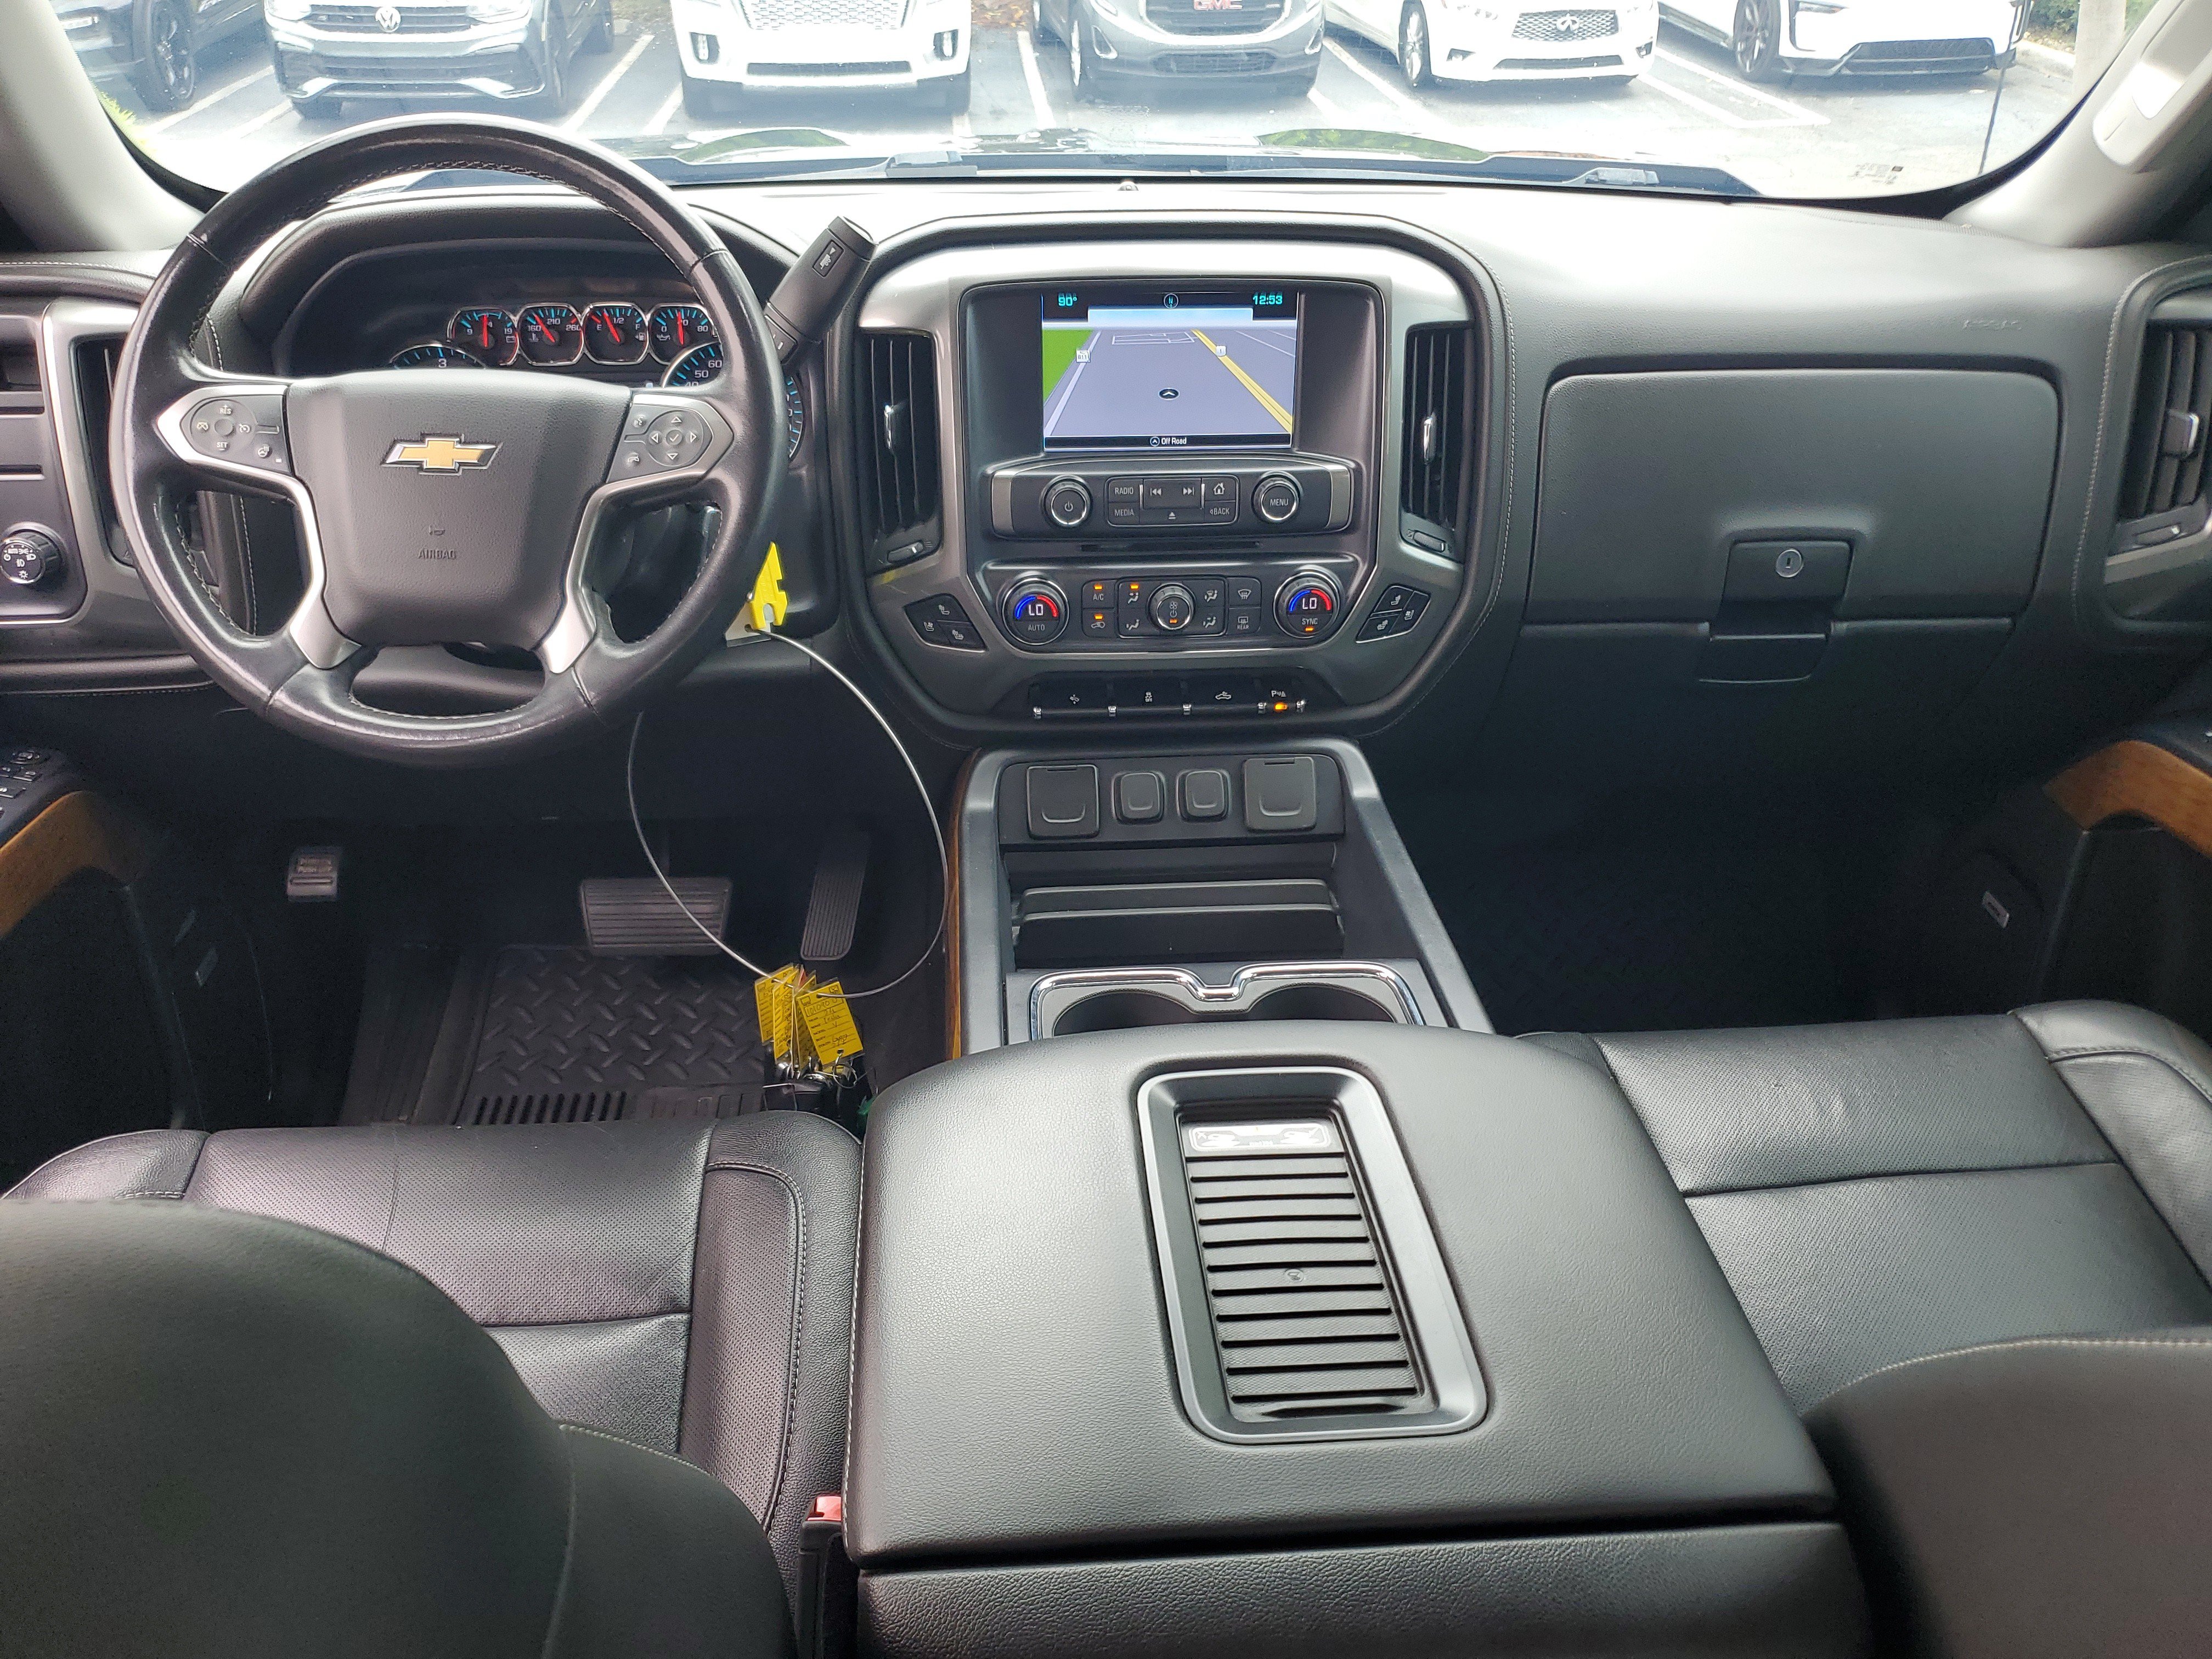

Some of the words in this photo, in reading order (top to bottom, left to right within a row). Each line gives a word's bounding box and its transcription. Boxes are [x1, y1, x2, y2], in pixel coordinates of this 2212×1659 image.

[1194, 0, 1243, 10] GMC
[1252, 295, 1283, 305] 12:53
[438, 358, 447, 368] 3
[708, 360, 723, 368] 60
[694, 370, 709, 378] 50
[1161, 437, 1171, 445] Off
[1171, 437, 1187, 445] Road
[1269, 498, 1289, 506] MENU
[1214, 507, 1230, 515] BACK
[1302, 597, 1317, 610] LO
[1029, 603, 1043, 616] LO
